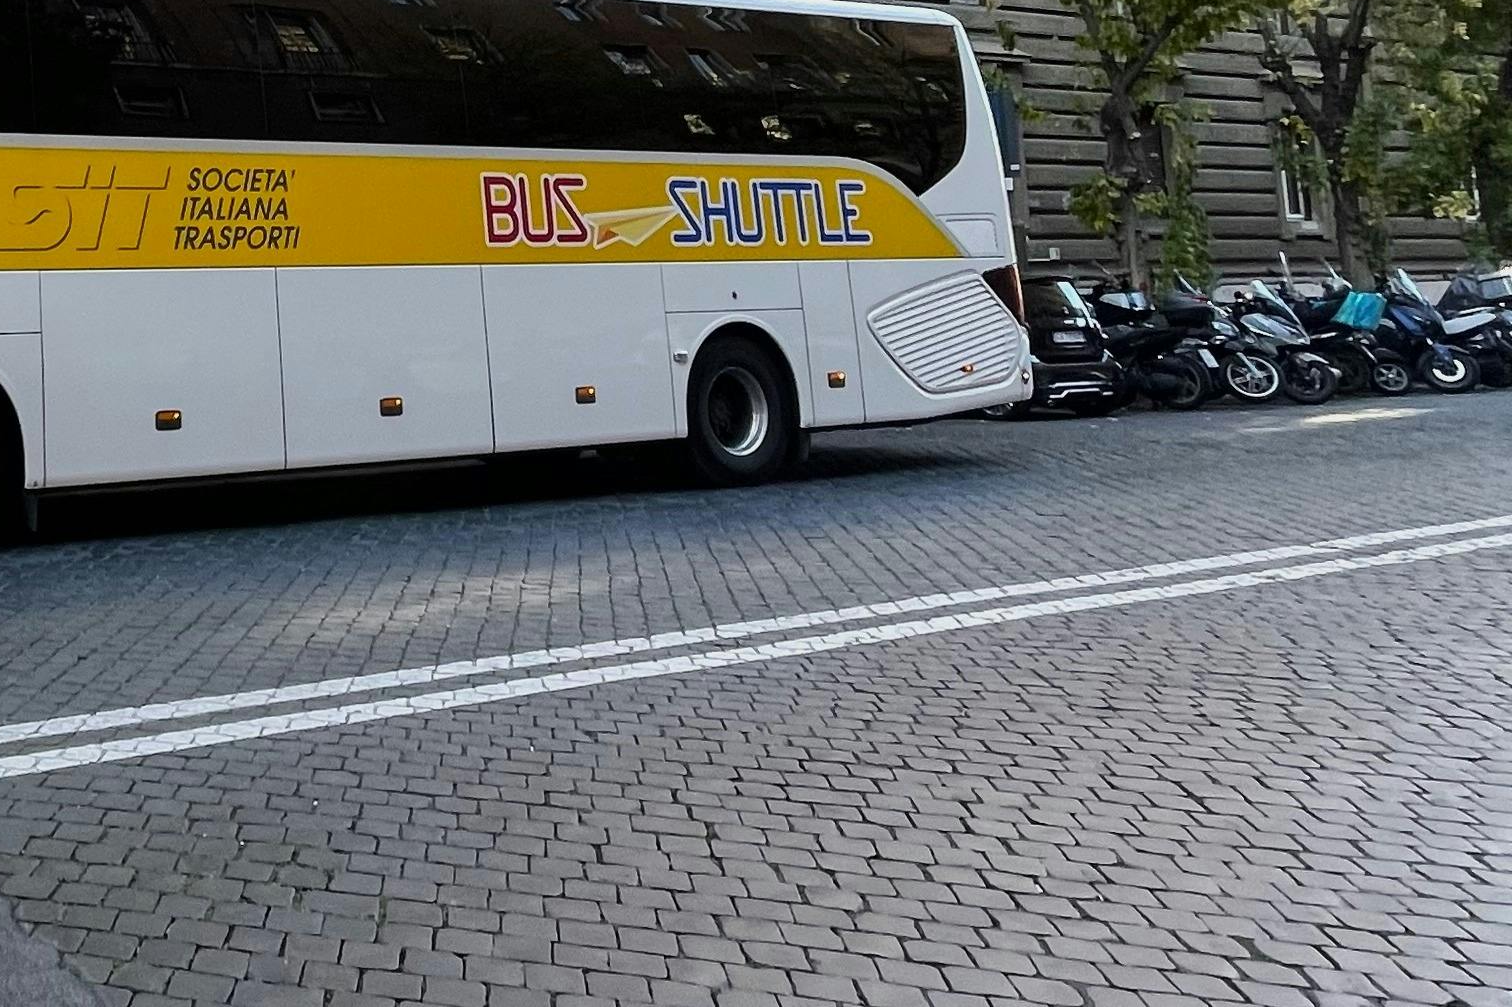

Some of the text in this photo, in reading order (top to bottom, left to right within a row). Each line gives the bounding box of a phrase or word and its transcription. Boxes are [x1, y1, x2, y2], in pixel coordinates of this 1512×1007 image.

[187, 167, 296, 192] SOCIETA'
[180, 197, 289, 221] ITALIANA
[480, 173, 873, 247] BUS SHUTTLE
[173, 225, 300, 250] TRASPORTI
